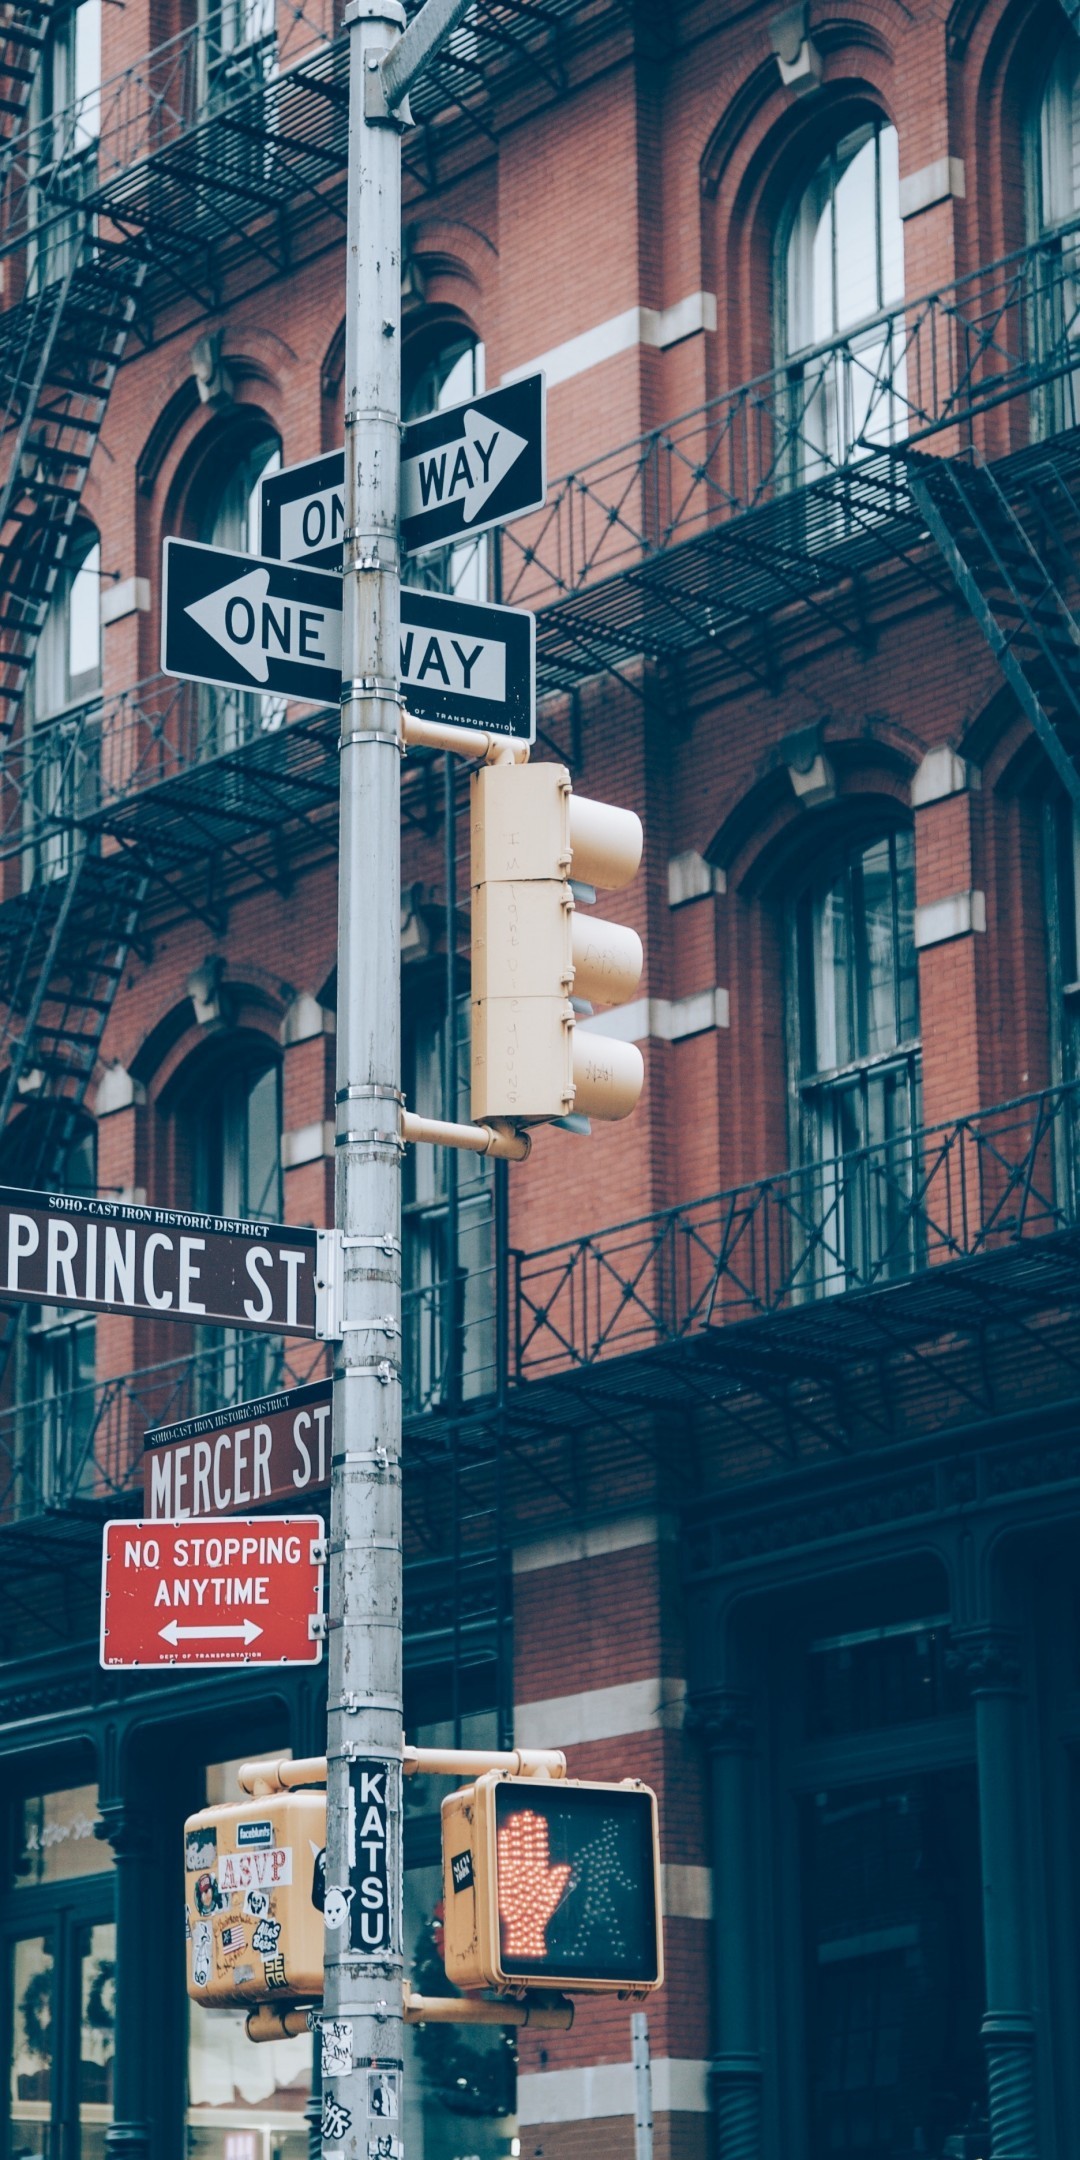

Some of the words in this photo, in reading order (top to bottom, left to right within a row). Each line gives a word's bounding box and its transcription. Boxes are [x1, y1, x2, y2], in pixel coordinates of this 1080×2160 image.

[302, 493, 344, 547] ON
[419, 431, 500, 507] WAY
[225, 596, 325, 661] ONE
[435, 712, 516, 732] TRANSPORTATION
[49, 1196, 119, 1217] SOHO-CAST
[121, 1206, 152, 1221] IRON
[154, 1210, 212, 1231] HISTORIC
[214, 1219, 270, 1238] DISTRICT
[8, 1213, 206, 1315] PRINCE
[243, 1246, 306, 1325] ST
[151, 1424, 192, 1445] SOHO-CAST
[194, 1416, 214, 1433] IRON
[215, 1405, 252, 1427] HISTORIC
[253, 1395, 290, 1416] DISTRICT
[151, 1423, 272, 1519] MERCER
[292, 1405, 331, 1488] ST
[124, 1540, 160, 1568] NO
[173, 1536, 301, 1567] STOPPING
[154, 1577, 270, 1607] ANYTIME
[240, 1825, 270, 1840] faceblunts
[221, 1850, 286, 1890] ASVP
[359, 1772, 386, 1945] KATSU
